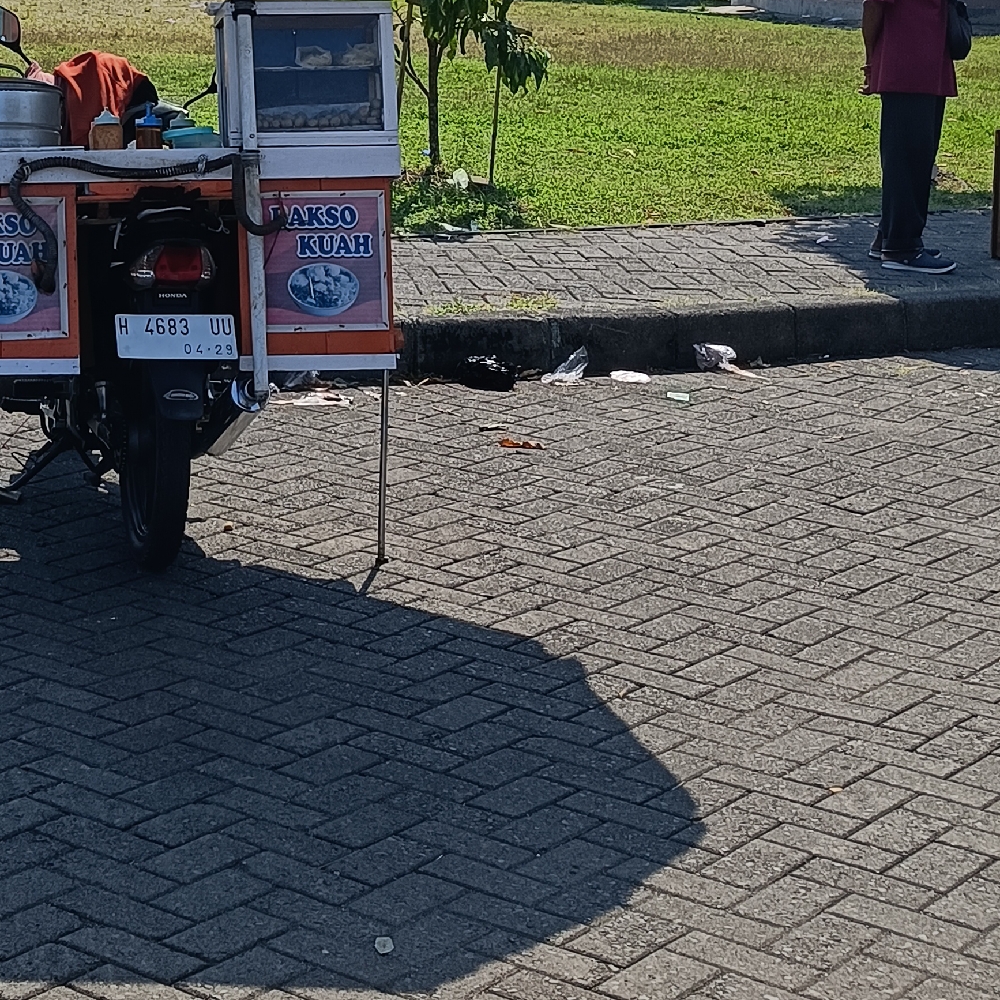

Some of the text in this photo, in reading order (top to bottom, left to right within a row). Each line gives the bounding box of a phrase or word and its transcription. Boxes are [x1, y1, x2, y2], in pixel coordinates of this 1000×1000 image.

[296, 233, 374, 258] KUAH
[118, 317, 233, 336] H 4683 UU
